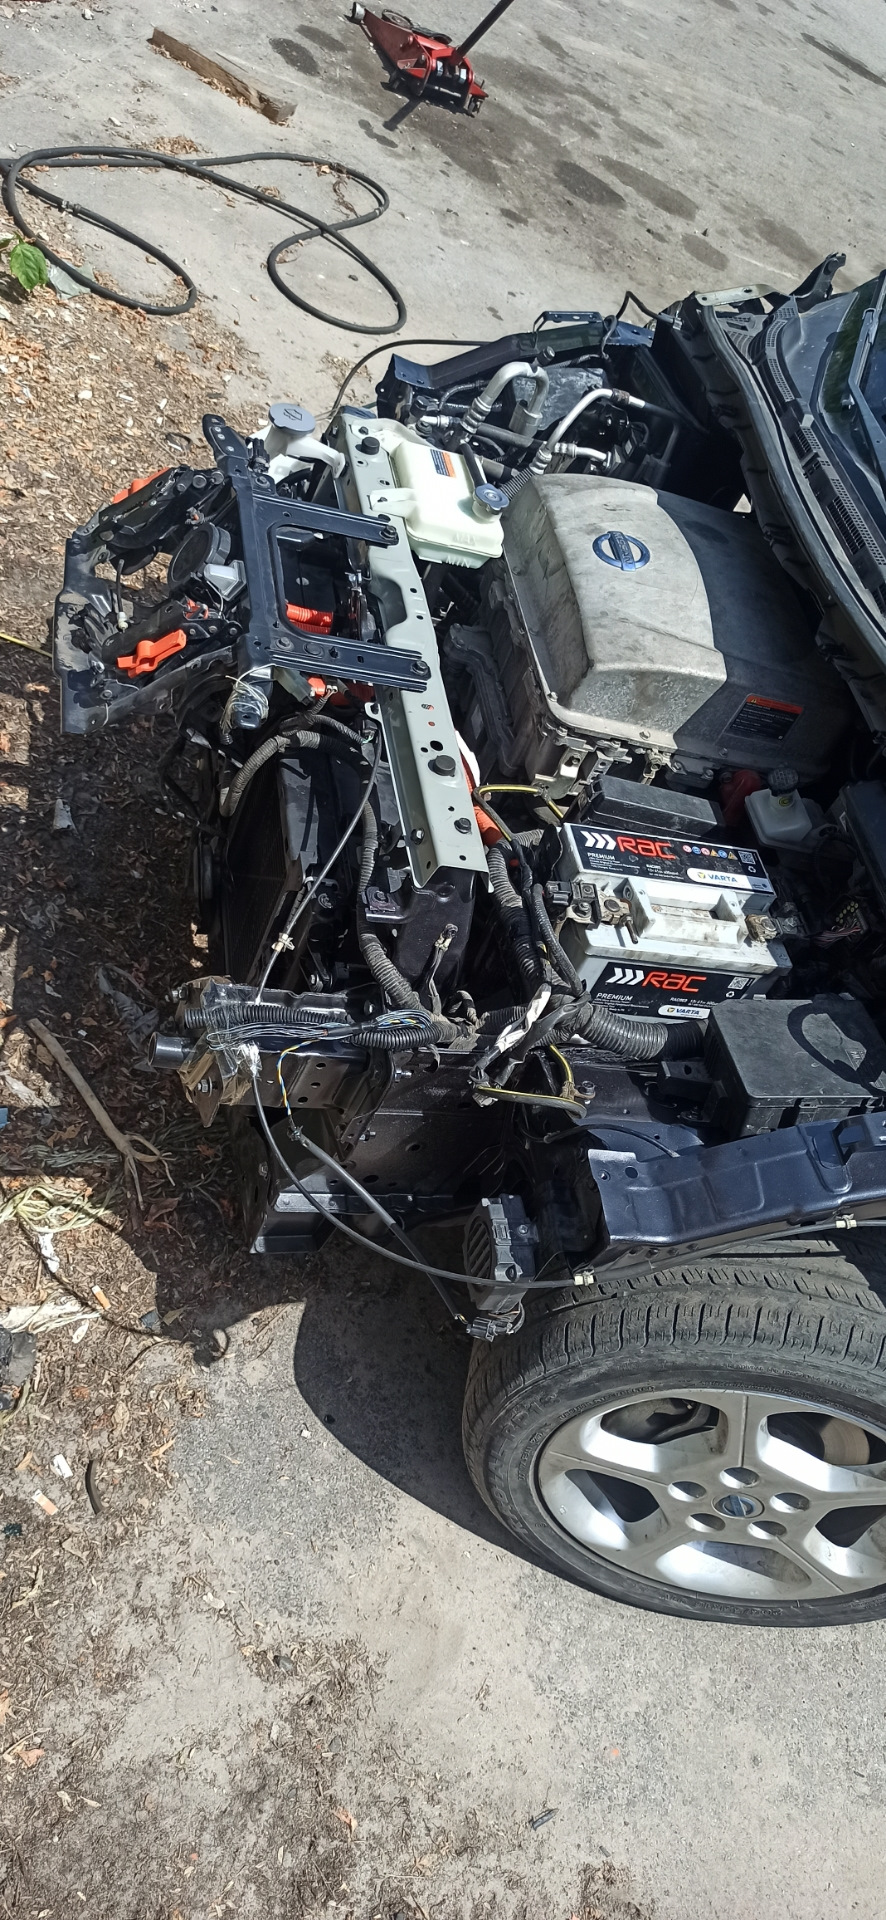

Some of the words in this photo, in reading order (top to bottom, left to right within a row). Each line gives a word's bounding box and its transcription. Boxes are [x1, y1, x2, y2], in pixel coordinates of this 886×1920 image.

[587, 852, 616, 861] PREMIUM
[707, 873, 738, 883] VARTA
[596, 992, 633, 1001] PREMIUM
[676, 1008, 700, 1016] VARTA
